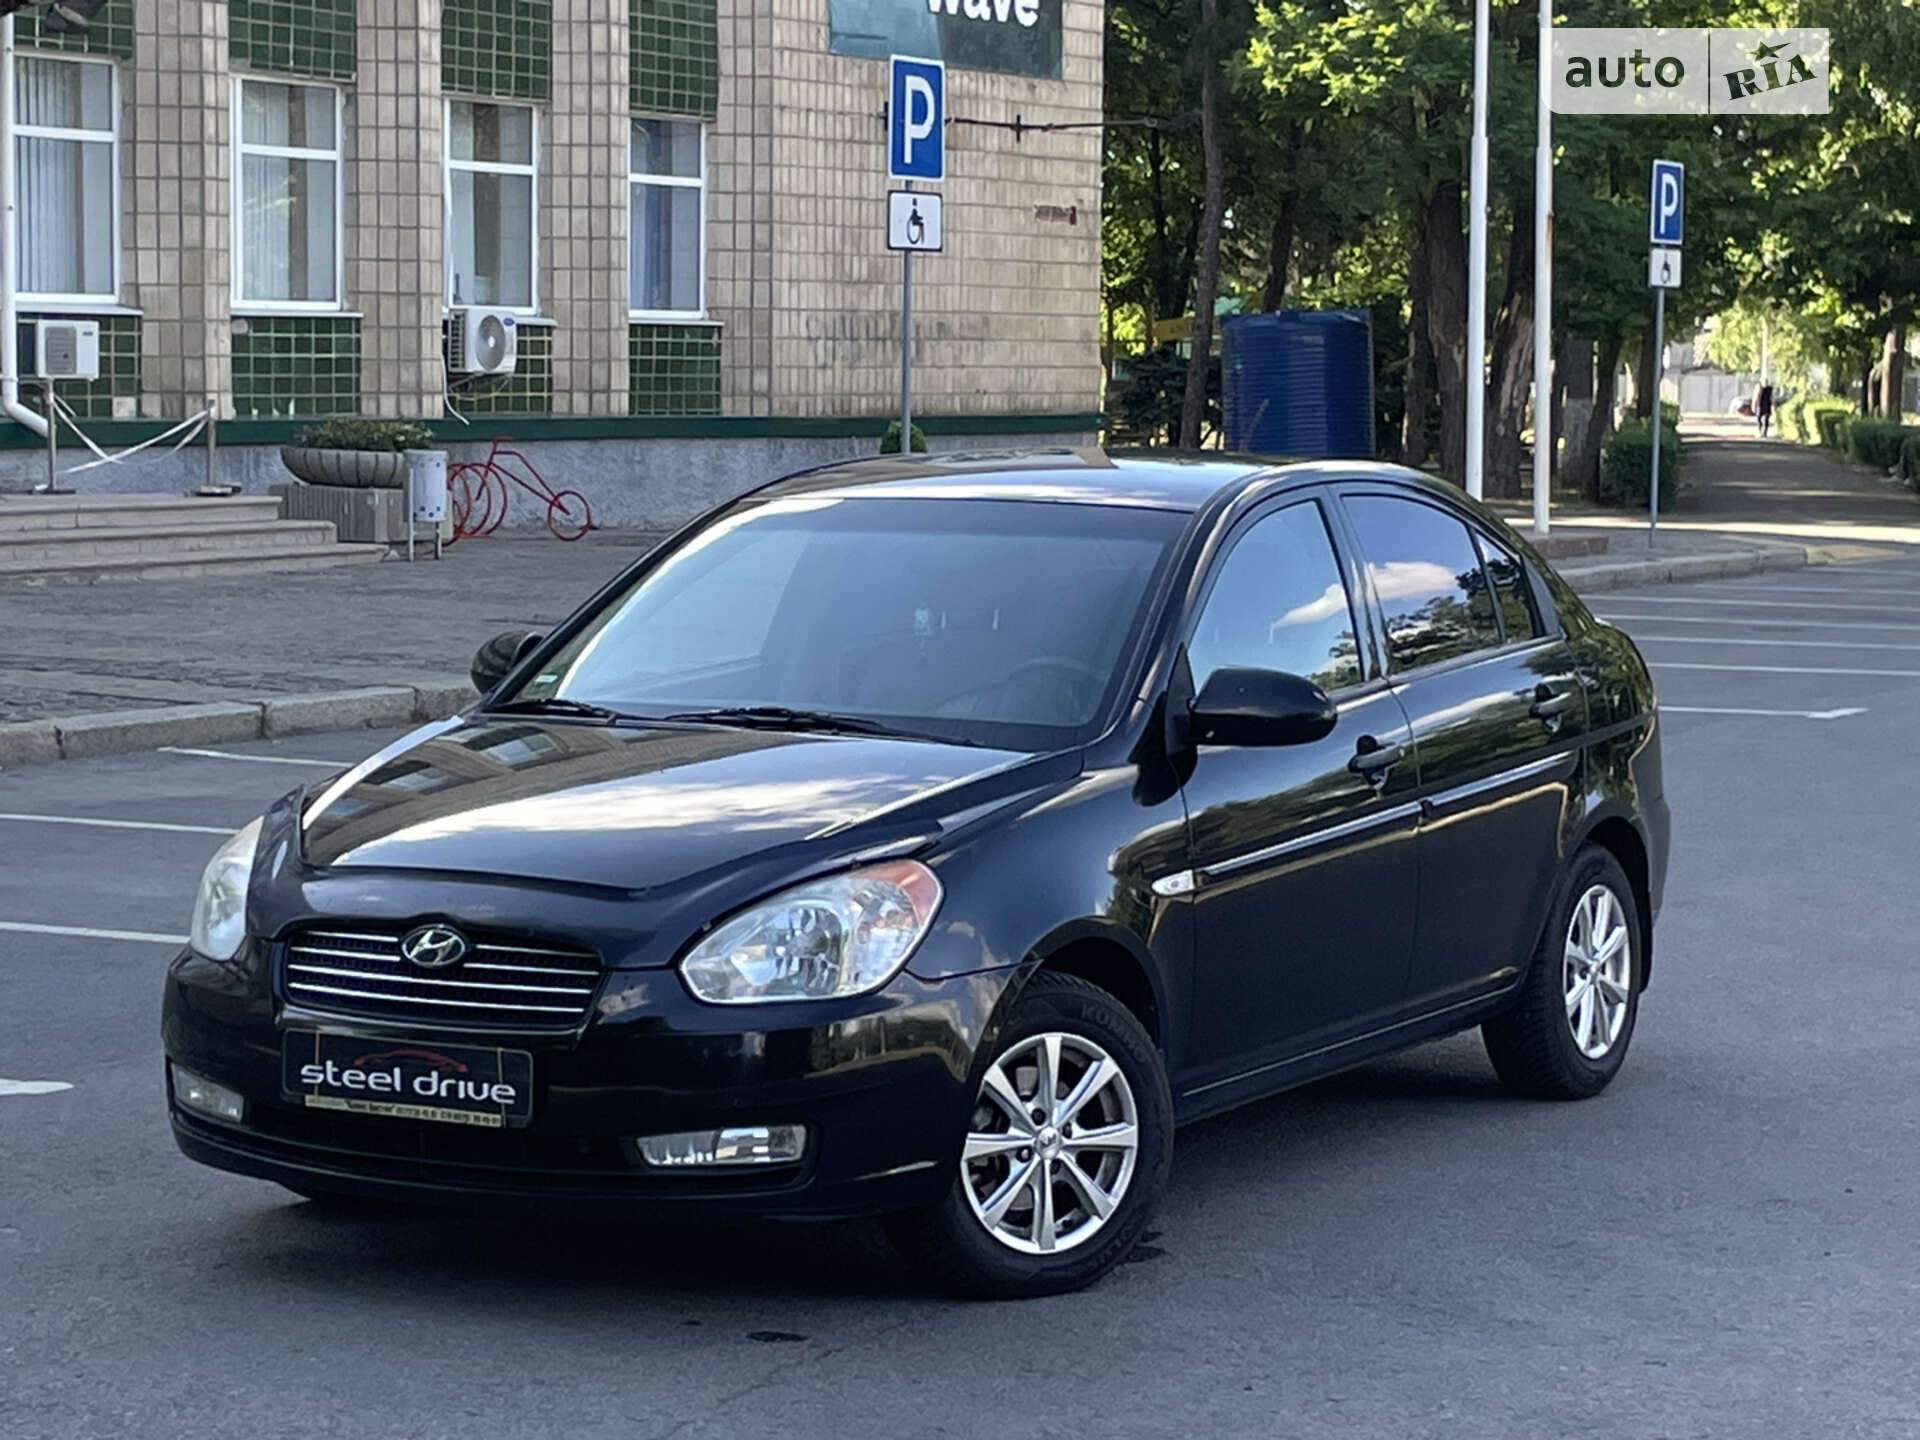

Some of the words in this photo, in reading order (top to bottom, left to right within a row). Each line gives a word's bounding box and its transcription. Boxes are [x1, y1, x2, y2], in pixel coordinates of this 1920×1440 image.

[904, 75, 936, 164] P
[1660, 172, 1679, 234] P
[301, 1060, 402, 1092] steel
[413, 1070, 516, 1104] drive
